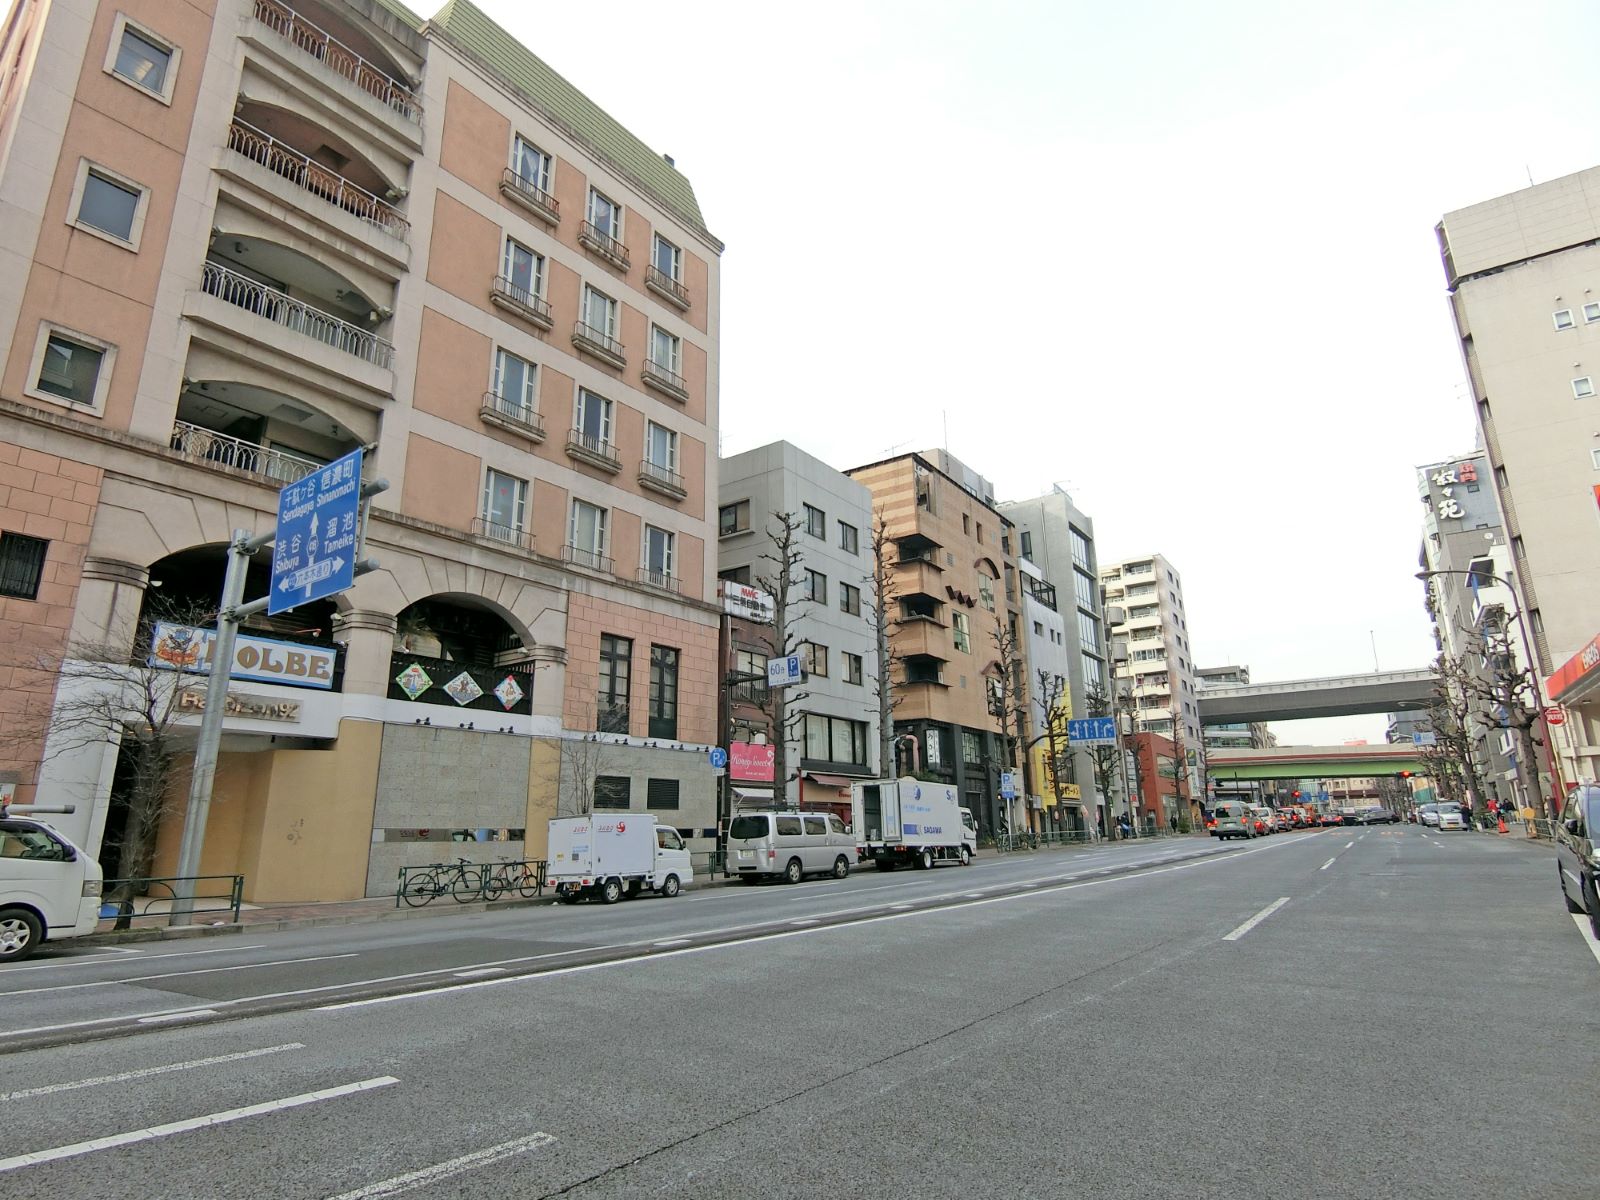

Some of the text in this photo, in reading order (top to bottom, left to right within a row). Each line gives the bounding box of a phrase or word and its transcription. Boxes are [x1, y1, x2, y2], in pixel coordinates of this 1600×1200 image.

[321, 459, 354, 490] 信濃町
[316, 478, 356, 508] Shinanomachi
[282, 498, 315, 523] Sendagaya
[326, 512, 354, 538] 溜池
[277, 534, 302, 557] 渋谷
[324, 533, 354, 553] Tameike
[275, 555, 300, 574] Shibuya
[791, 659, 797, 670] P
